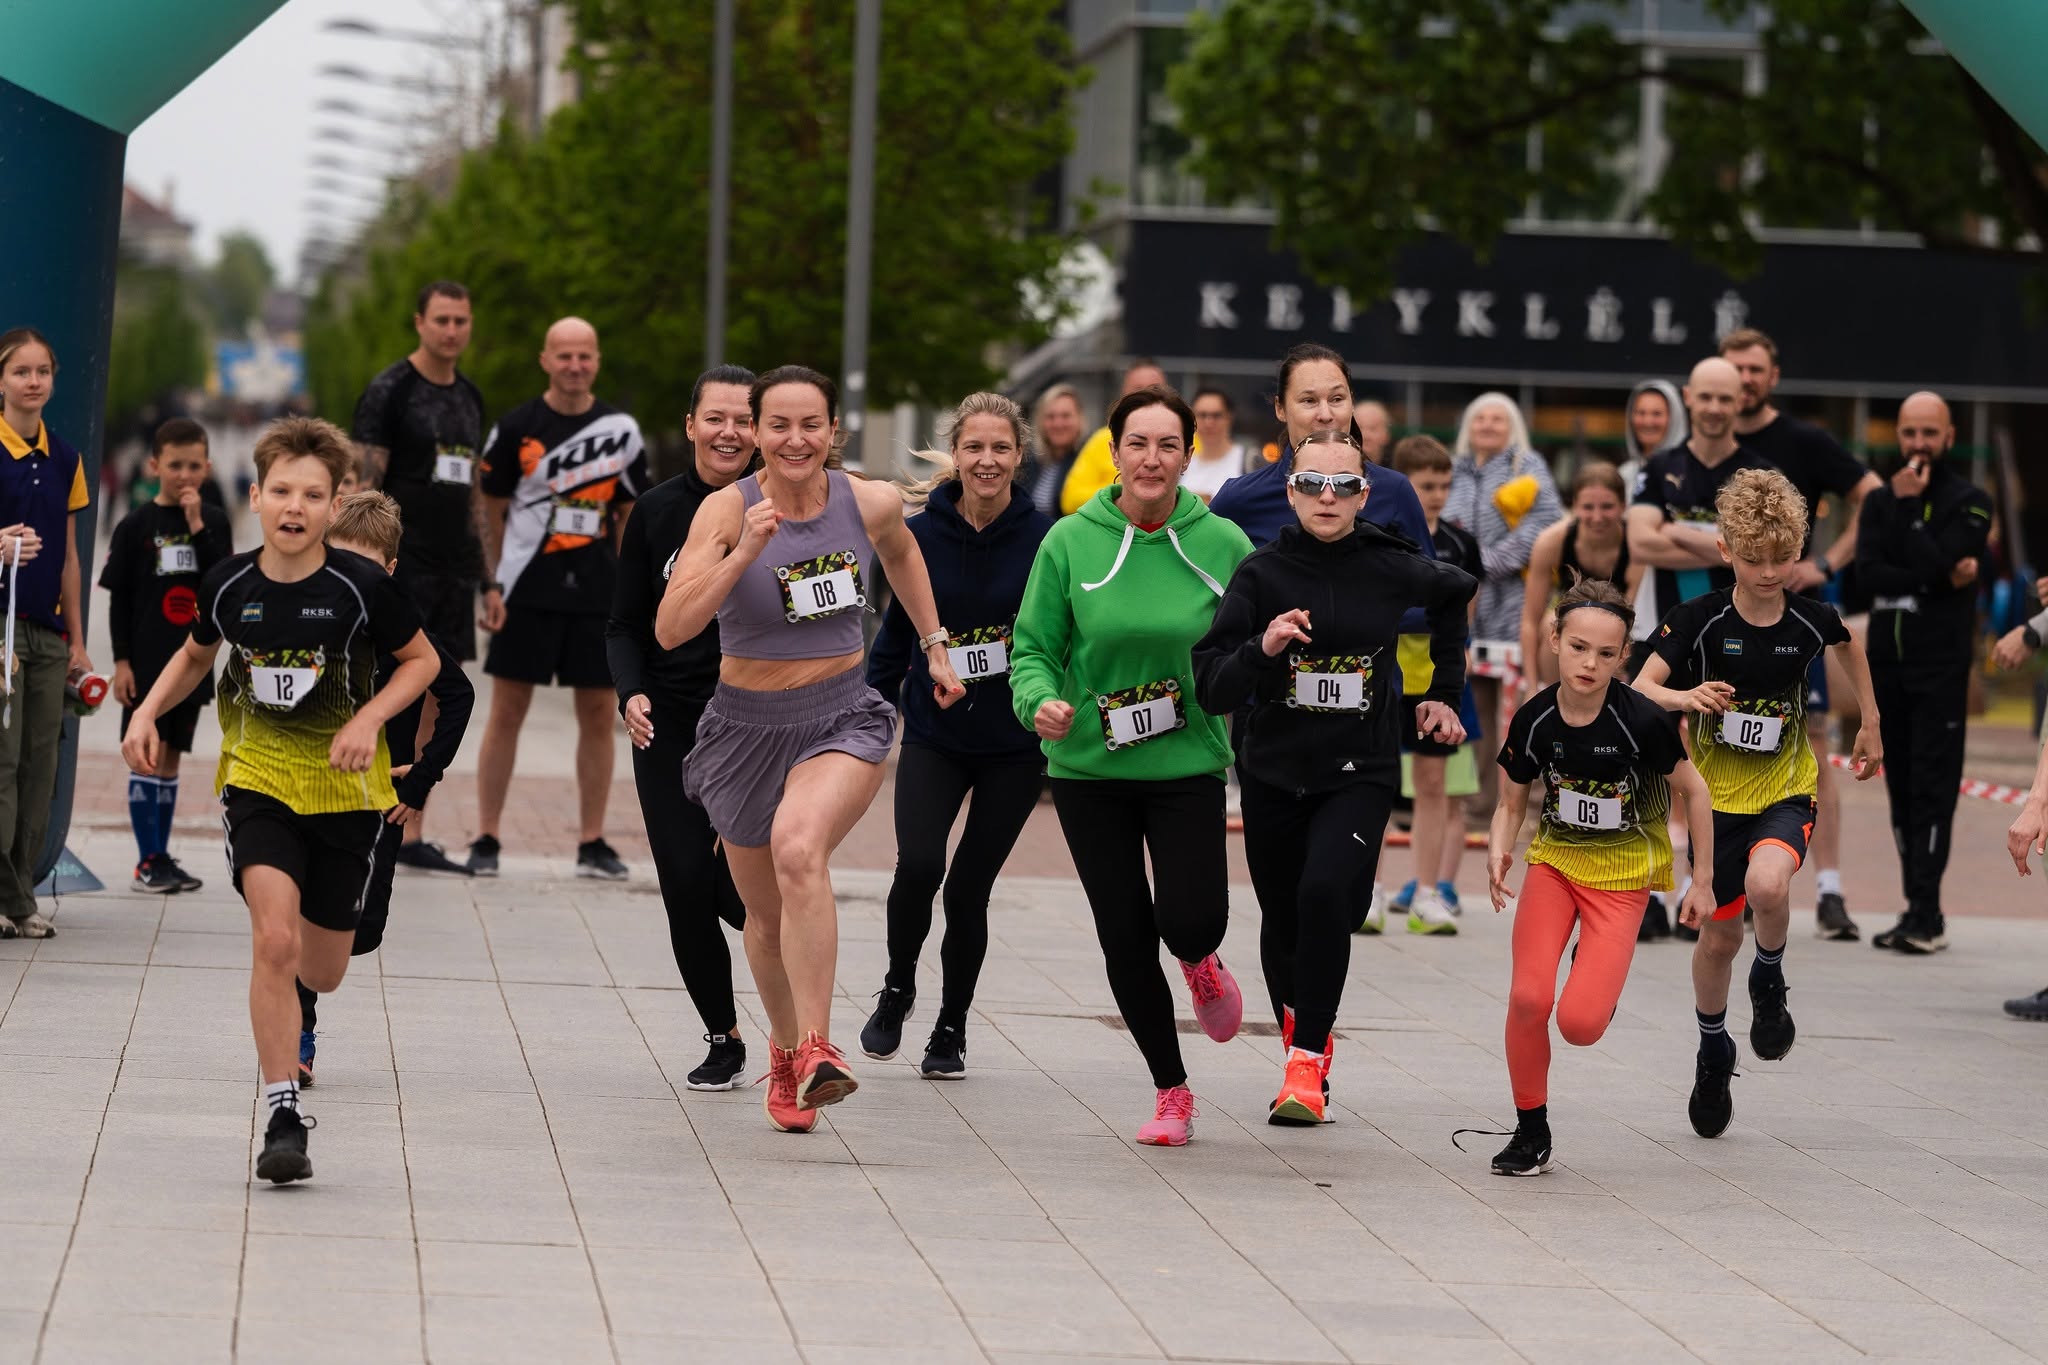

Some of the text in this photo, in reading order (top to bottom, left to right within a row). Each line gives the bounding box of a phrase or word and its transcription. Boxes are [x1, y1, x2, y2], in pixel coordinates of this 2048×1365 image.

[547, 432, 630, 479] KTM
[176, 550, 192, 568] 09
[812, 580, 837, 608] 08
[302, 608, 333, 616] RKSK
[967, 650, 989, 675] 06
[274, 674, 293, 701] 12
[1318, 679, 1341, 704] 04
[1131, 708, 1152, 735] 07
[1740, 720, 1763, 746] 02
[1578, 799, 1599, 825] 03
